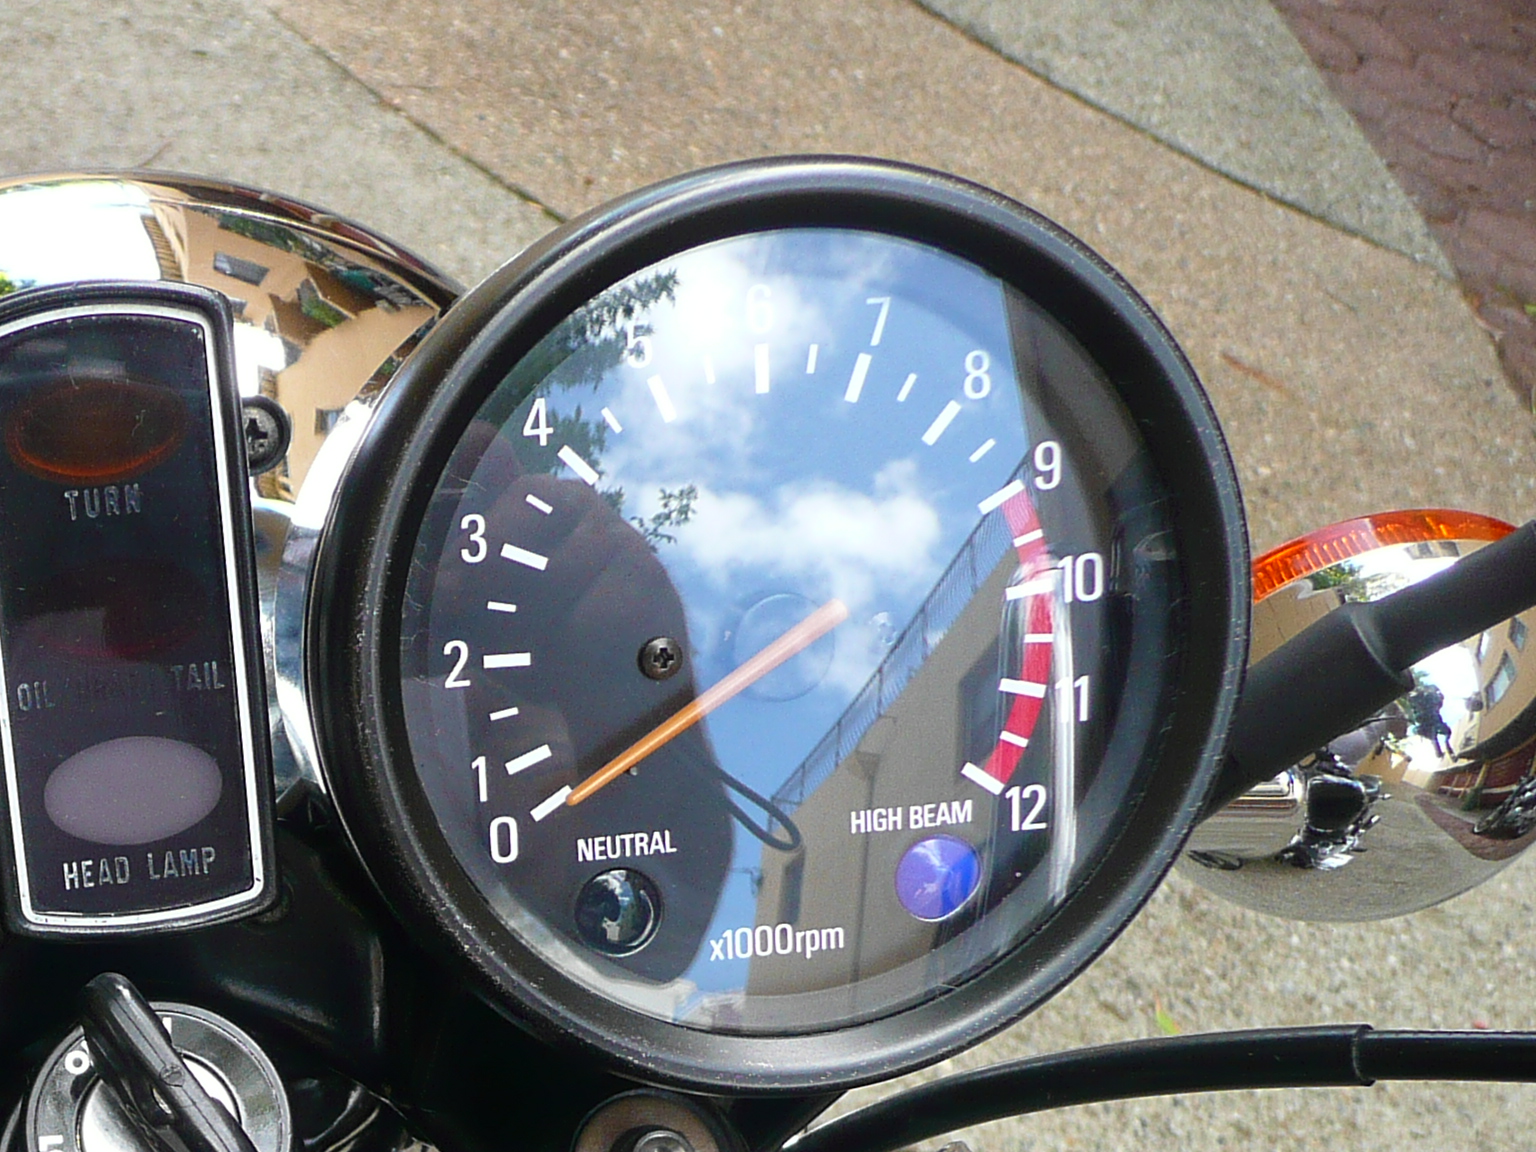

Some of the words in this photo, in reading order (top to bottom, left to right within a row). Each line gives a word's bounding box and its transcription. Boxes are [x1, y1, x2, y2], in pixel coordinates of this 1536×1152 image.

[746, 284, 773, 334] 6
[866, 296, 892, 346] 7
[626, 320, 654, 368] 5
[963, 349, 991, 400] 8
[522, 397, 554, 447] 4
[1033, 440, 1063, 491] 9
[64, 483, 142, 521] TURN
[460, 513, 488, 564] 3
[1057, 552, 1104, 603] 10
[16, 680, 56, 712] OIL
[170, 660, 225, 691] TAIL
[442, 639, 471, 689] 2
[1054, 674, 1090, 723] 11
[470, 755, 489, 803] 1
[849, 806, 905, 835] HIGH
[908, 798, 974, 831] BEAM
[1004, 783, 1048, 832] 12
[488, 816, 520, 864] 0
[576, 829, 678, 863] NEUTRAL
[62, 857, 130, 891] HEAD
[147, 847, 216, 880] LAMP
